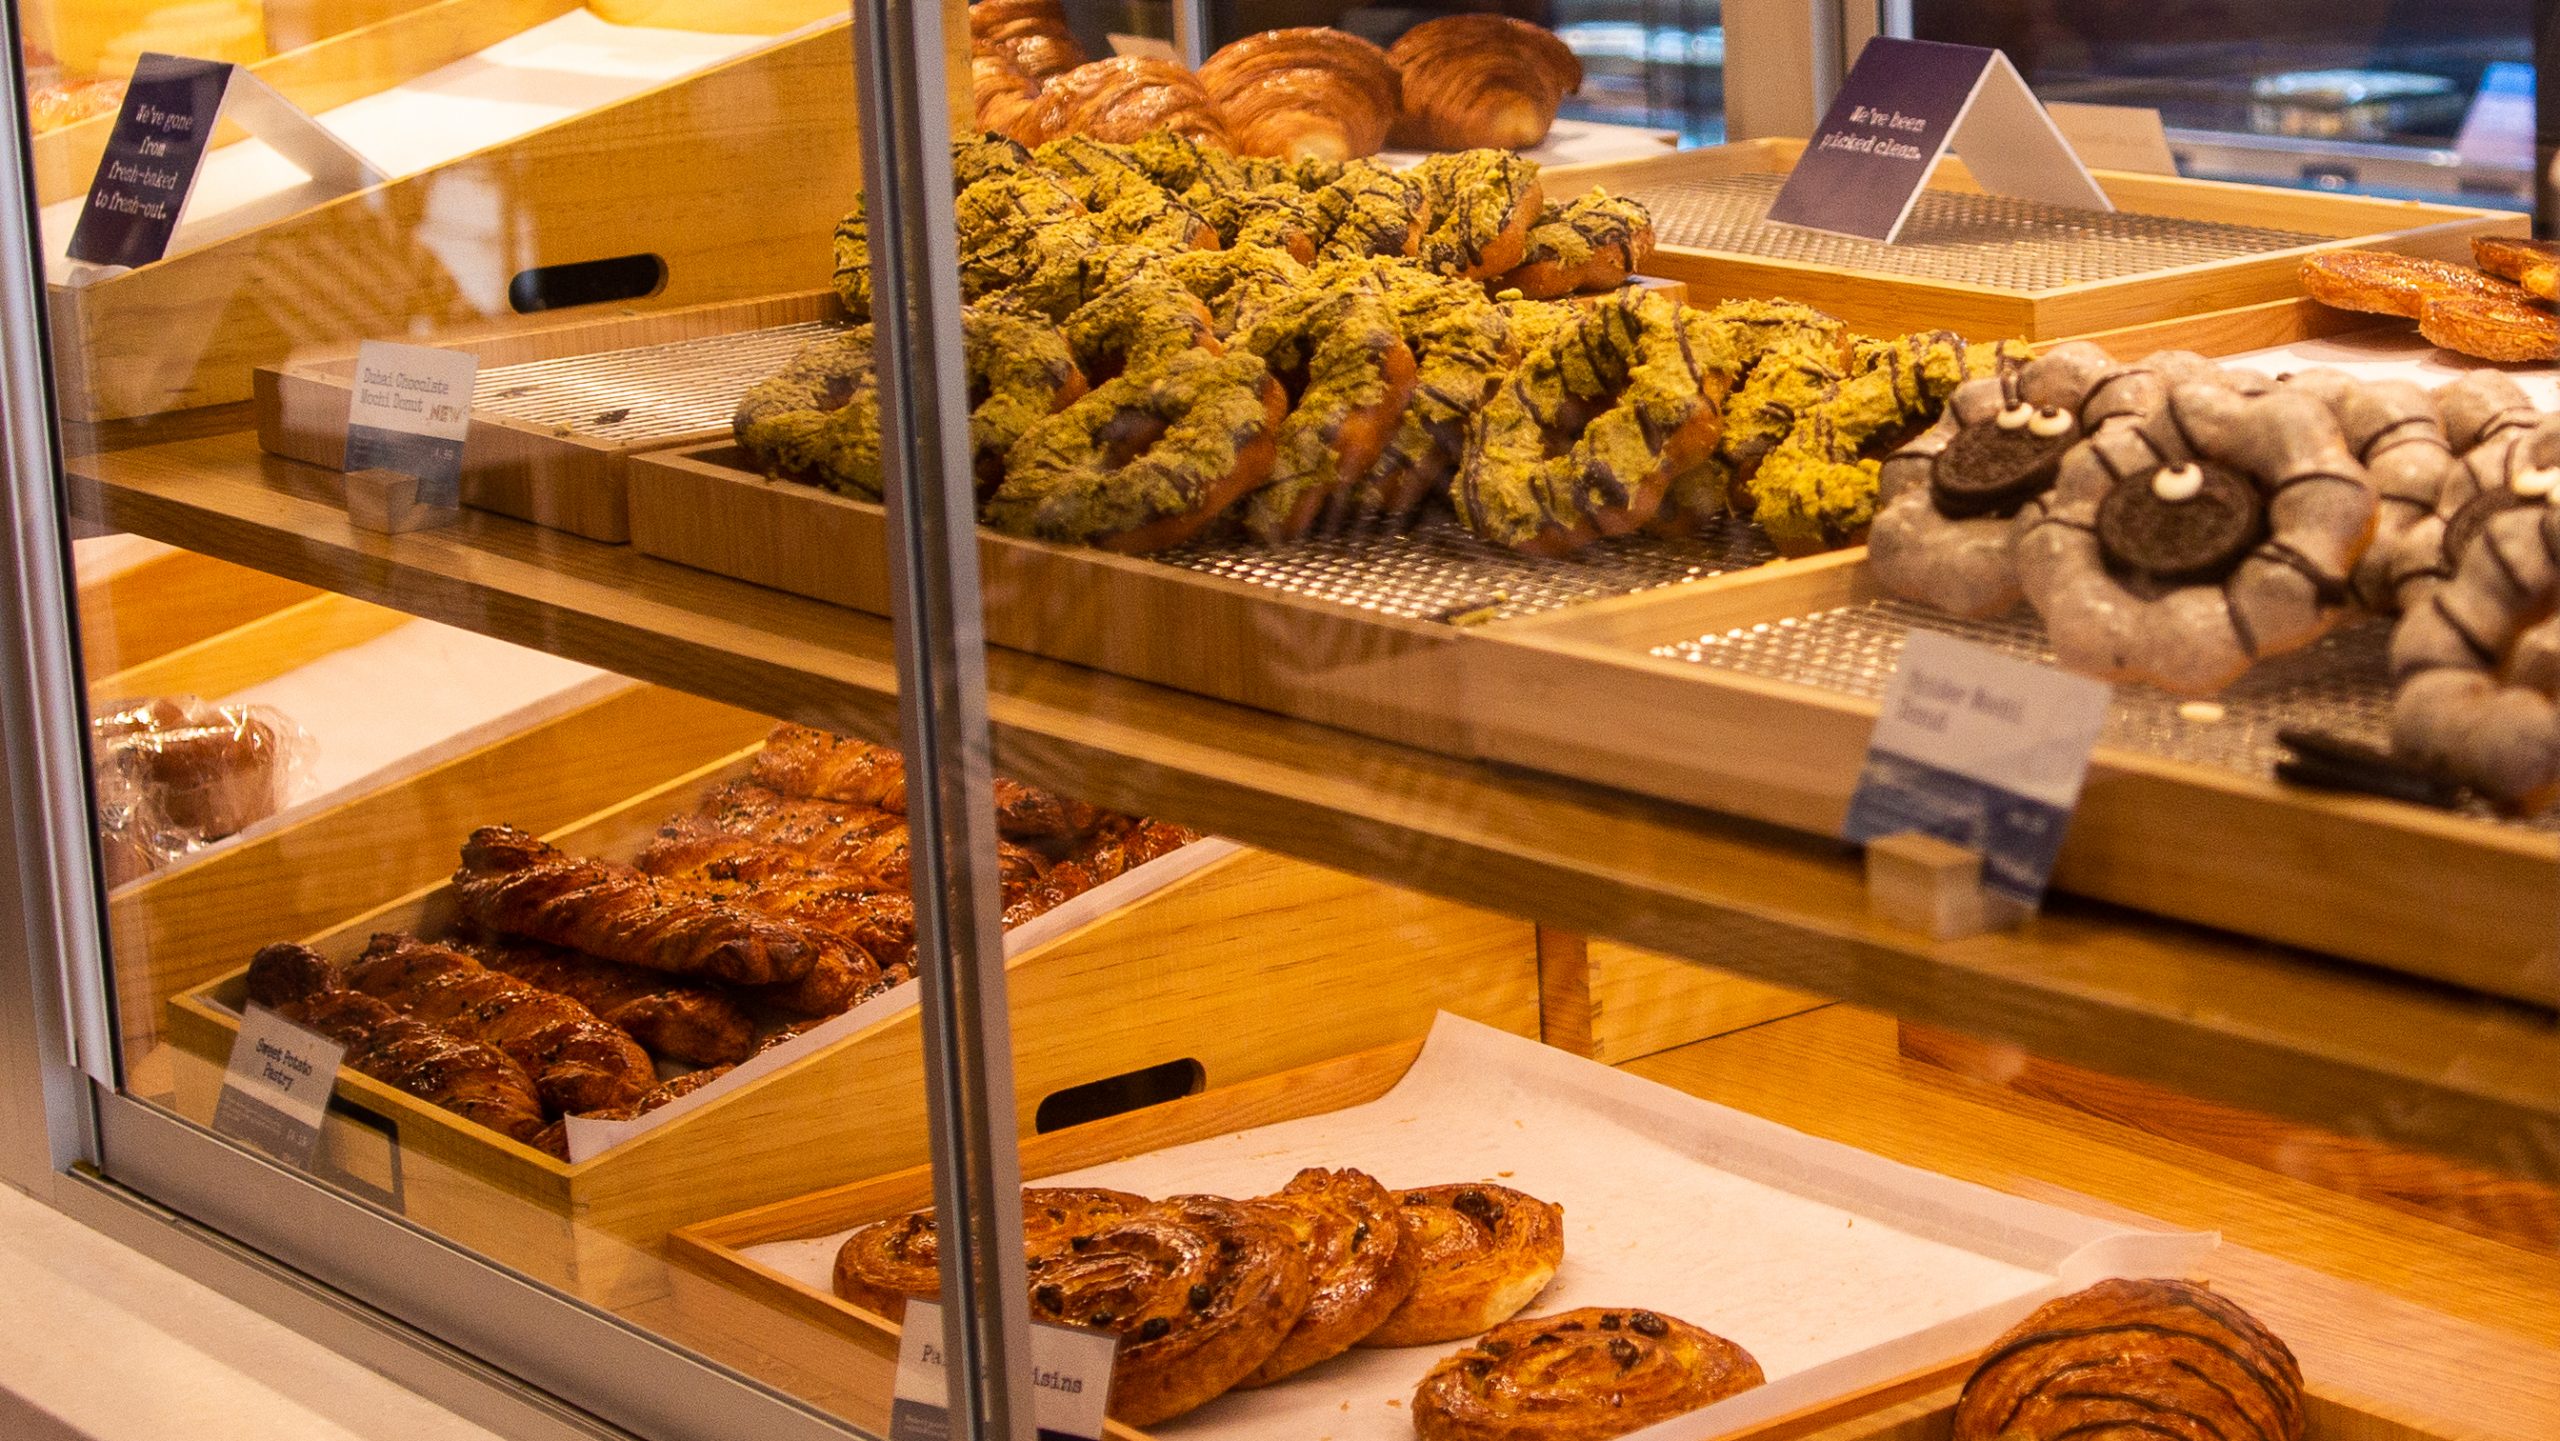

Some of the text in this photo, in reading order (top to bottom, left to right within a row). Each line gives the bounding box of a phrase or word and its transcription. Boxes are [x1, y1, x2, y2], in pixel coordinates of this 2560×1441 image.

[136, 104, 194, 132] We've gone
[1848, 105, 1927, 133] We've been
[139, 136, 167, 157] from
[1818, 131, 1922, 160] picked clean.
[108, 160, 179, 190] fresh-baked
[95, 189, 167, 219] to fresh-out.
[396, 372, 449, 395] Chocolate
[255, 1037, 313, 1077] Sweet Potato
[262, 1061, 294, 1092] Pastry
[921, 1343, 1083, 1394] Pa isins
